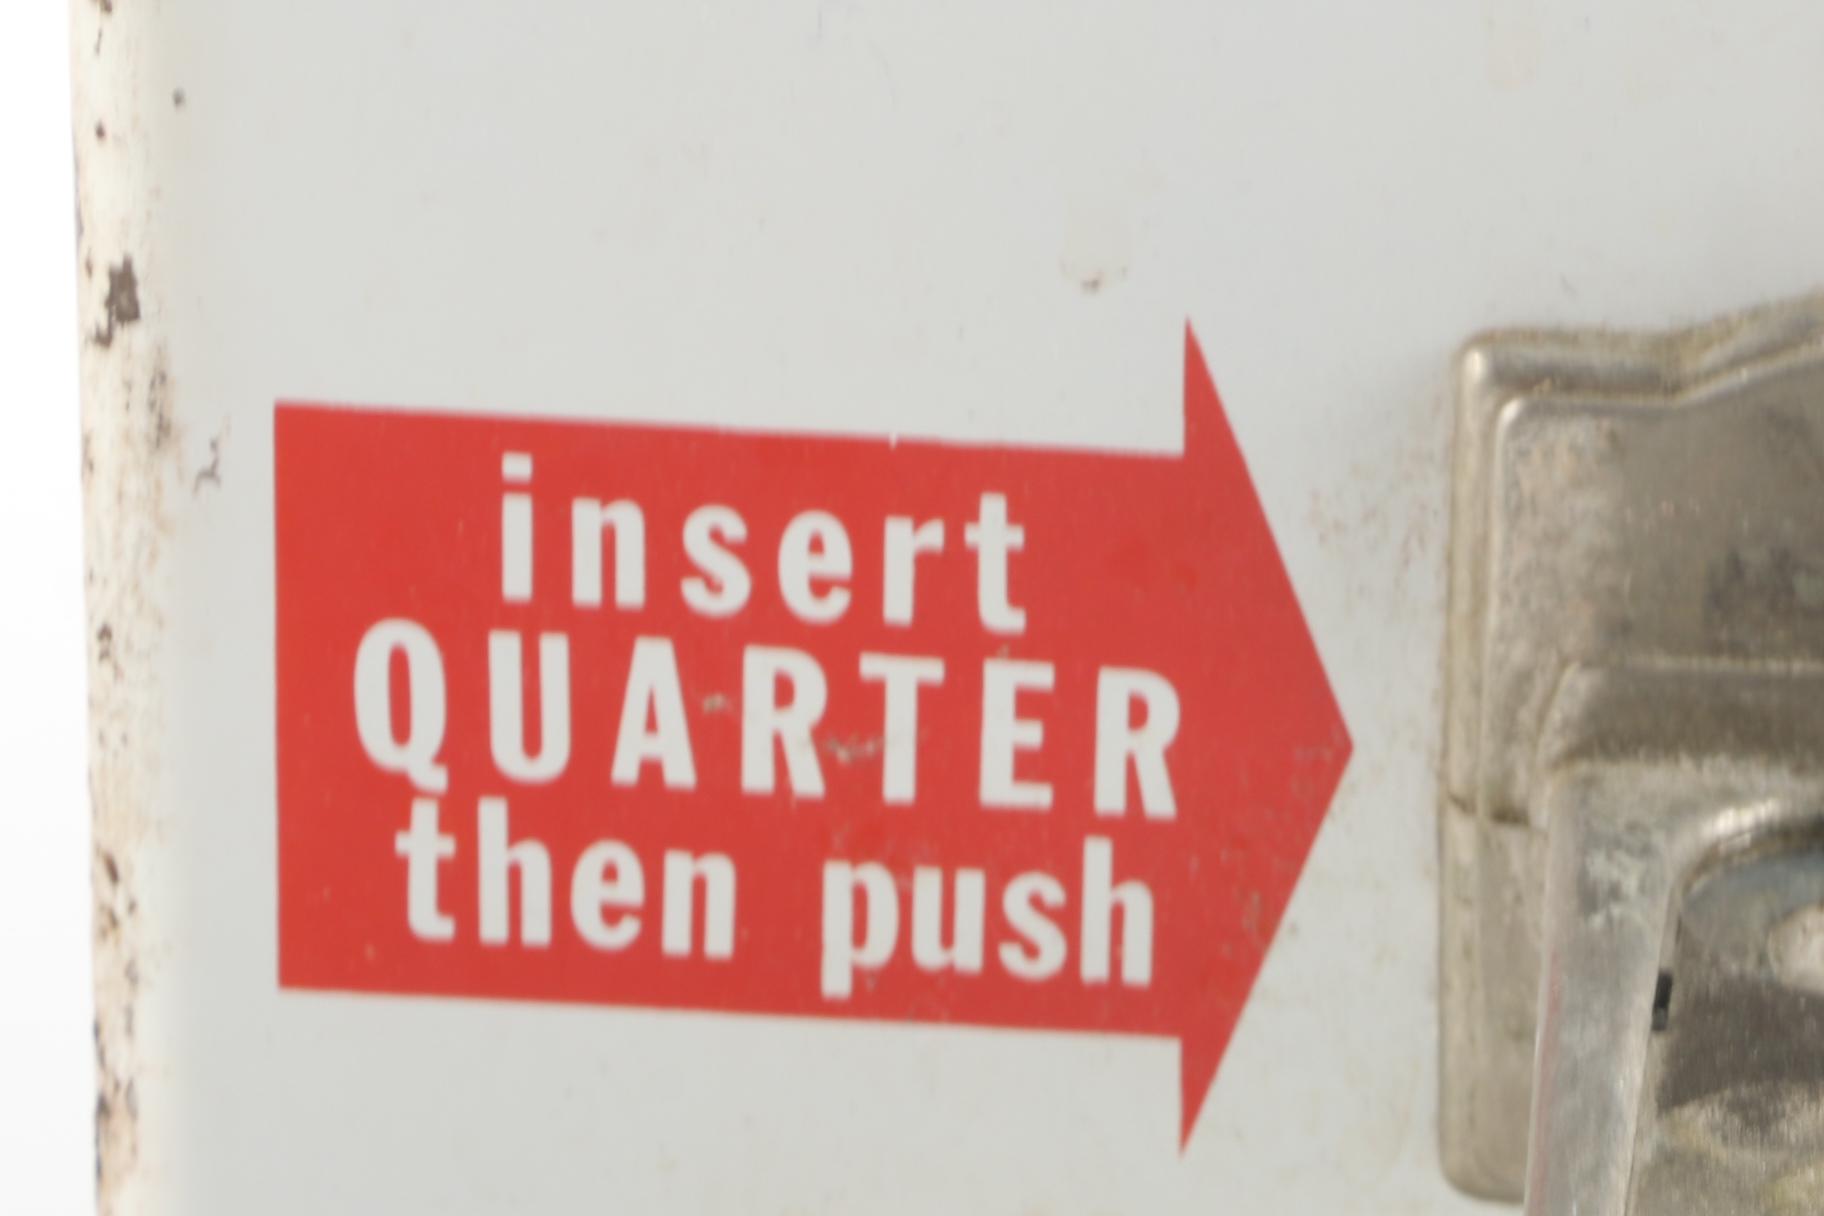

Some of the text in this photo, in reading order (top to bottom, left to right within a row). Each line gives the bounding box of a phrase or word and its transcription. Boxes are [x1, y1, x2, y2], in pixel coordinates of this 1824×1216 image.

[500, 451, 1028, 635] insert
[352, 617, 1182, 820] QUARTER
[394, 796, 1155, 999] then push
